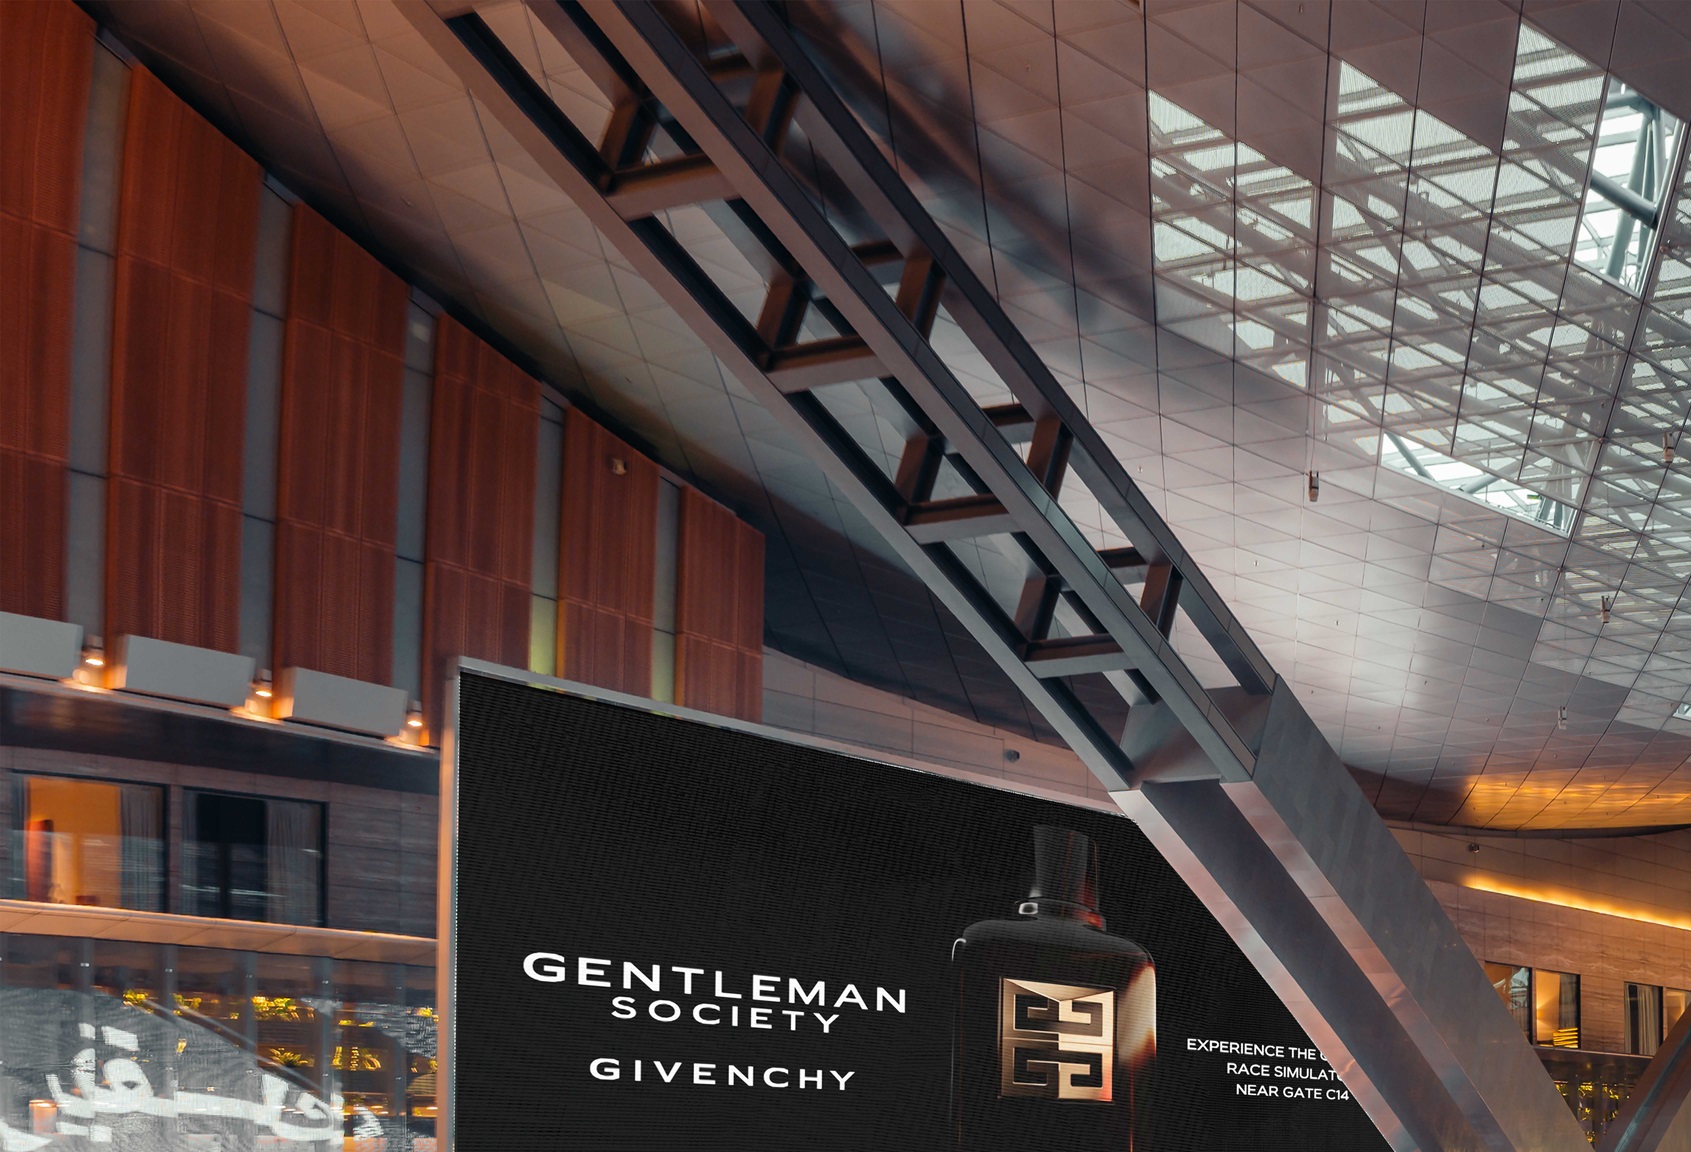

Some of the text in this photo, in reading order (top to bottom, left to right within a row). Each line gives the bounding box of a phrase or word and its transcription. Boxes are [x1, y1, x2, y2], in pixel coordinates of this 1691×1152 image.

[524, 953, 905, 1013] GENTLEMAN
[612, 997, 839, 1033] SOCIETY
[1187, 1039, 1284, 1057] EXPERIENCE
[1289, 1047, 1316, 1060] THE
[590, 1058, 854, 1090] GIVENCHY
[1227, 1063, 1343, 1081] RACE SIMULAT
[1237, 1084, 1349, 1101] NEAR GATE C14
